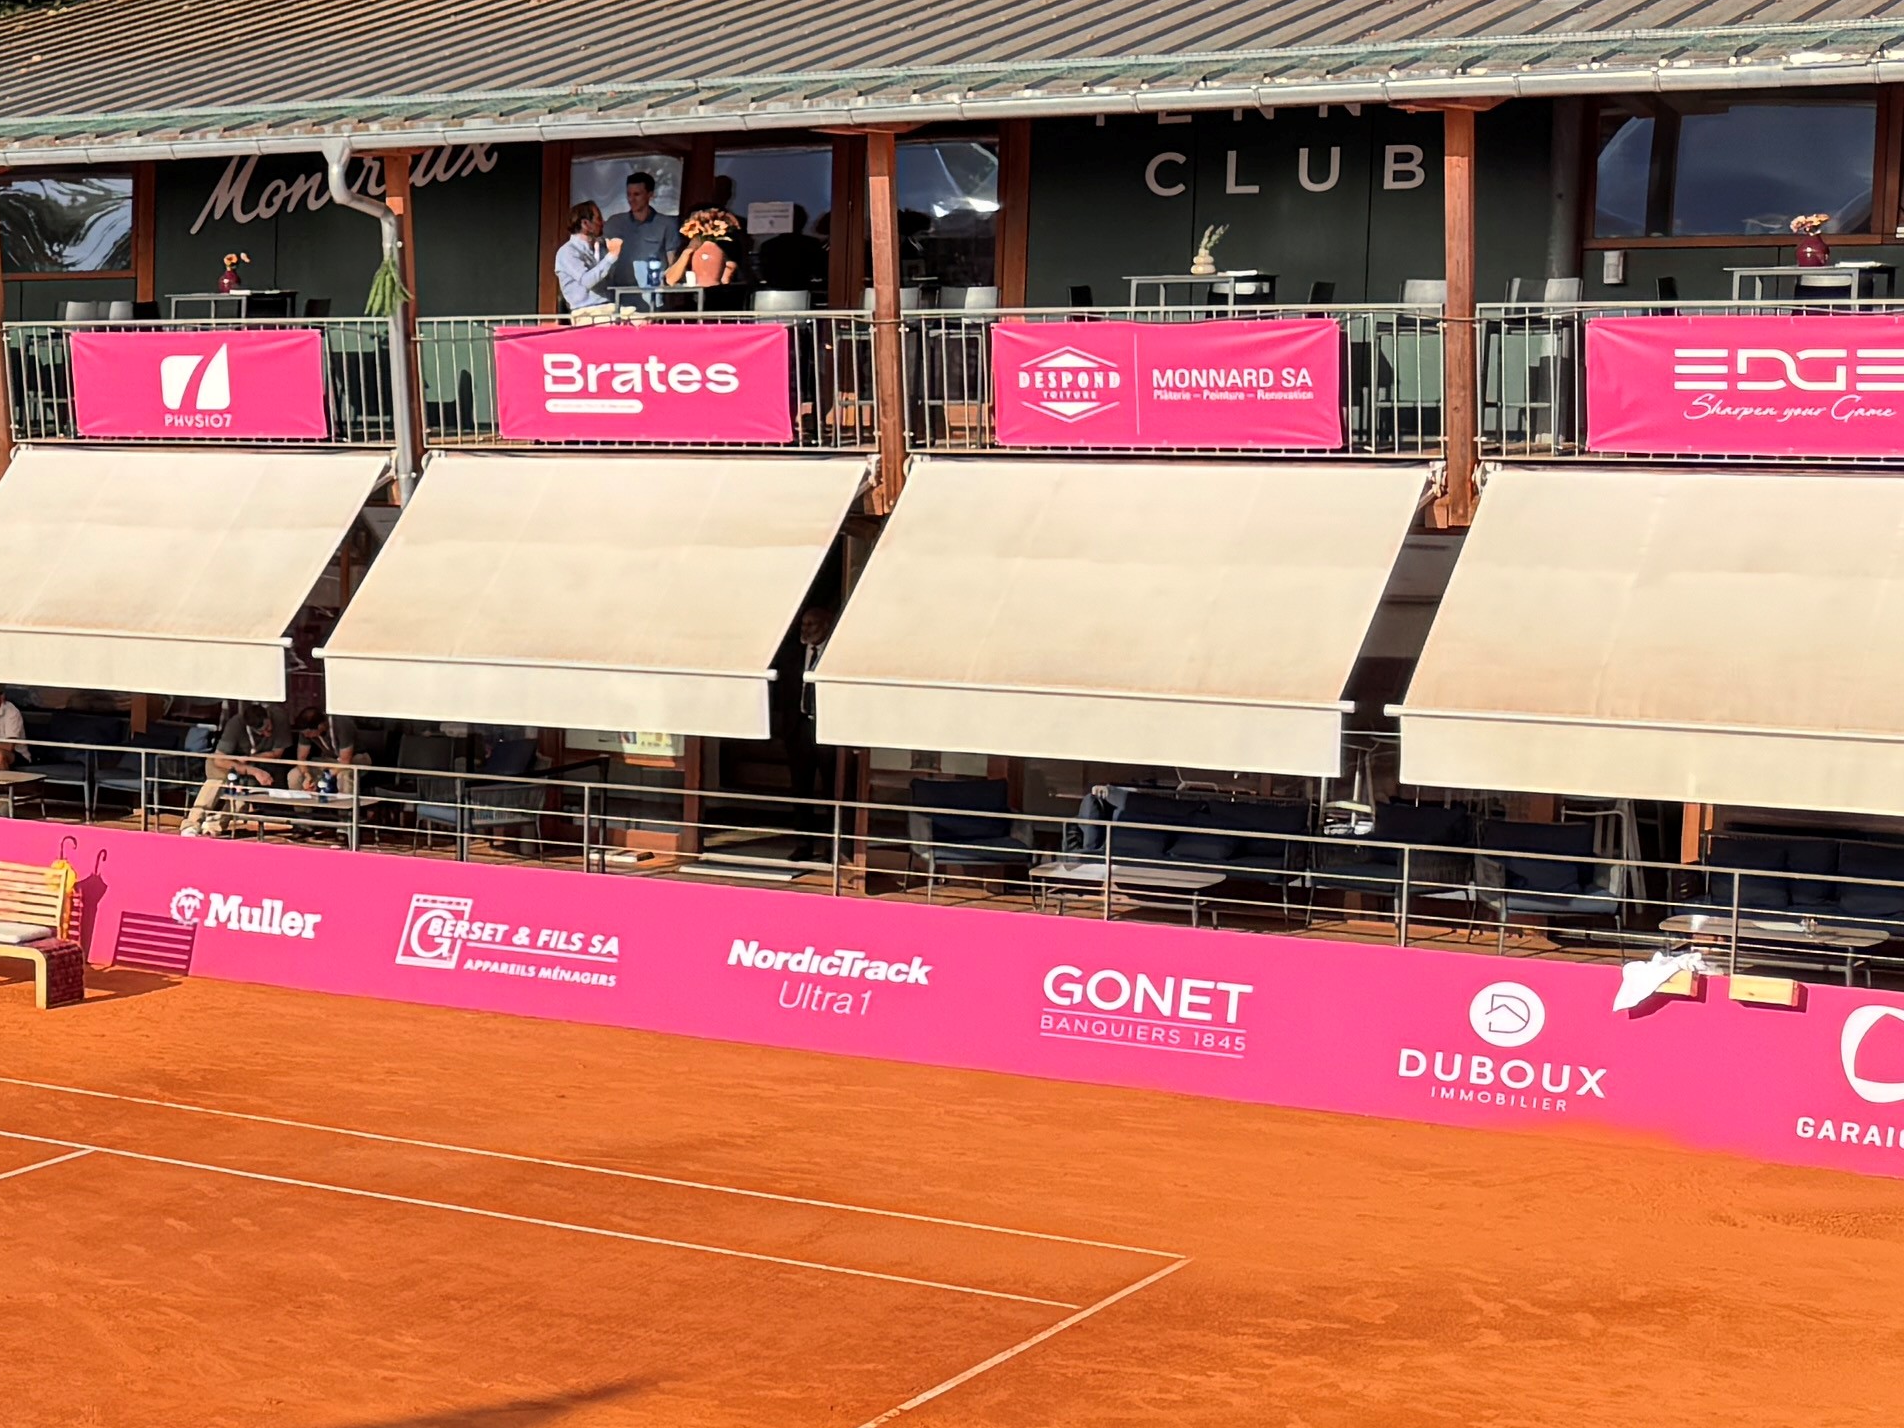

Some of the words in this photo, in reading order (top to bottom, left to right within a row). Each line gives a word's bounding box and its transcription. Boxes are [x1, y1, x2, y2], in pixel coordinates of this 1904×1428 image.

[1145, 144, 1426, 197] CLUB
[543, 353, 740, 394] Brates
[1018, 371, 1120, 389] DESPOND
[1153, 368, 1274, 388] MONNARD
[1281, 368, 1313, 388] SA
[1674, 348, 1904, 391] EDGE
[1684, 393, 1777, 420] Sharpen
[1777, 406, 1826, 422] your
[1831, 394, 1896, 423] Game
[203, 892, 322, 939] Muller
[428, 918, 510, 942] BERSET
[512, 926, 531, 945] &
[537, 929, 585, 952] FILS
[587, 935, 620, 956] SA
[463, 958, 536, 978] APPAREILS
[538, 965, 617, 988] MÉNAGERS
[727, 939, 933, 985] NordicTrack
[1043, 964, 1254, 1024] GONET
[1040, 1014, 1181, 1045] BANQUIERS
[1193, 1031, 1246, 1052] 1845
[1398, 1048, 1607, 1099] DUBOUX
[1431, 1086, 1567, 1112] IMMOBILIER
[1796, 1116, 1904, 1149] GARAI
